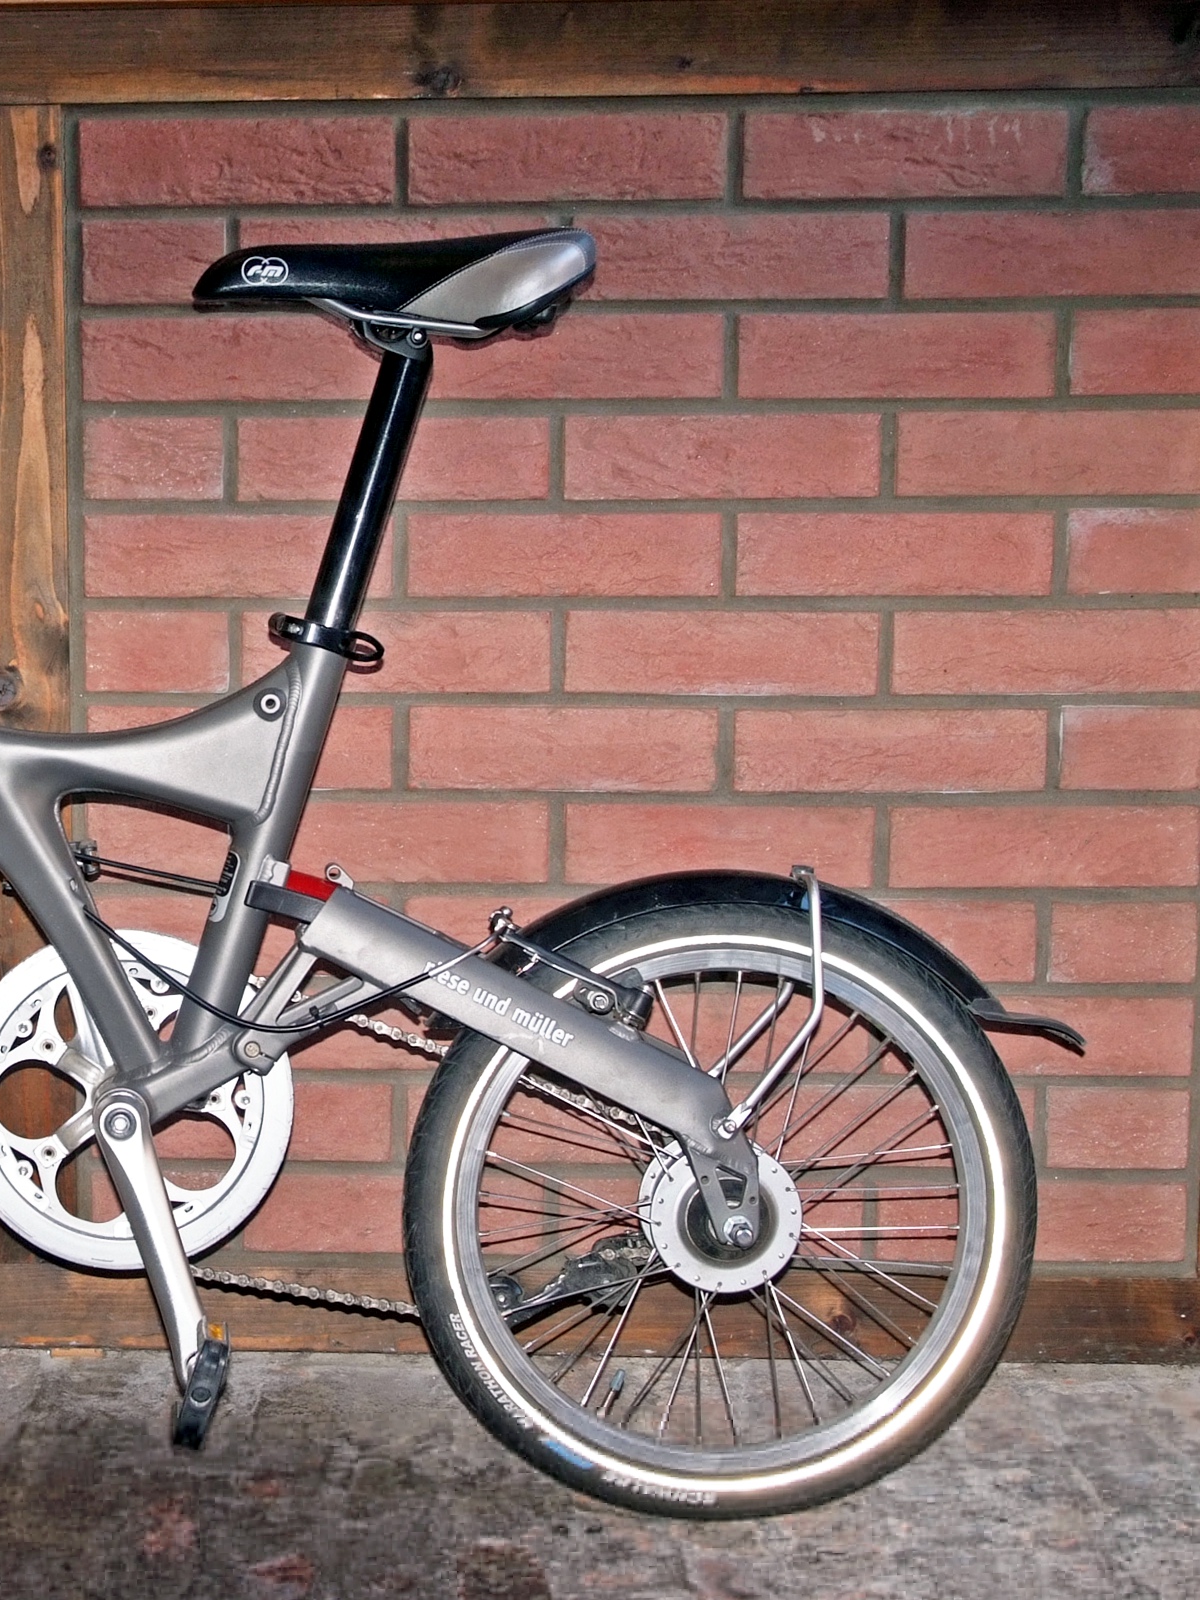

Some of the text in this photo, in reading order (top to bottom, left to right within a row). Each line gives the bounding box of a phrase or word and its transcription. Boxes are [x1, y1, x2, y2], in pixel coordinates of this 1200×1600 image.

[472, 987, 512, 1016] und
[511, 1007, 575, 1048] müller
[449, 1313, 479, 1359] RACER
